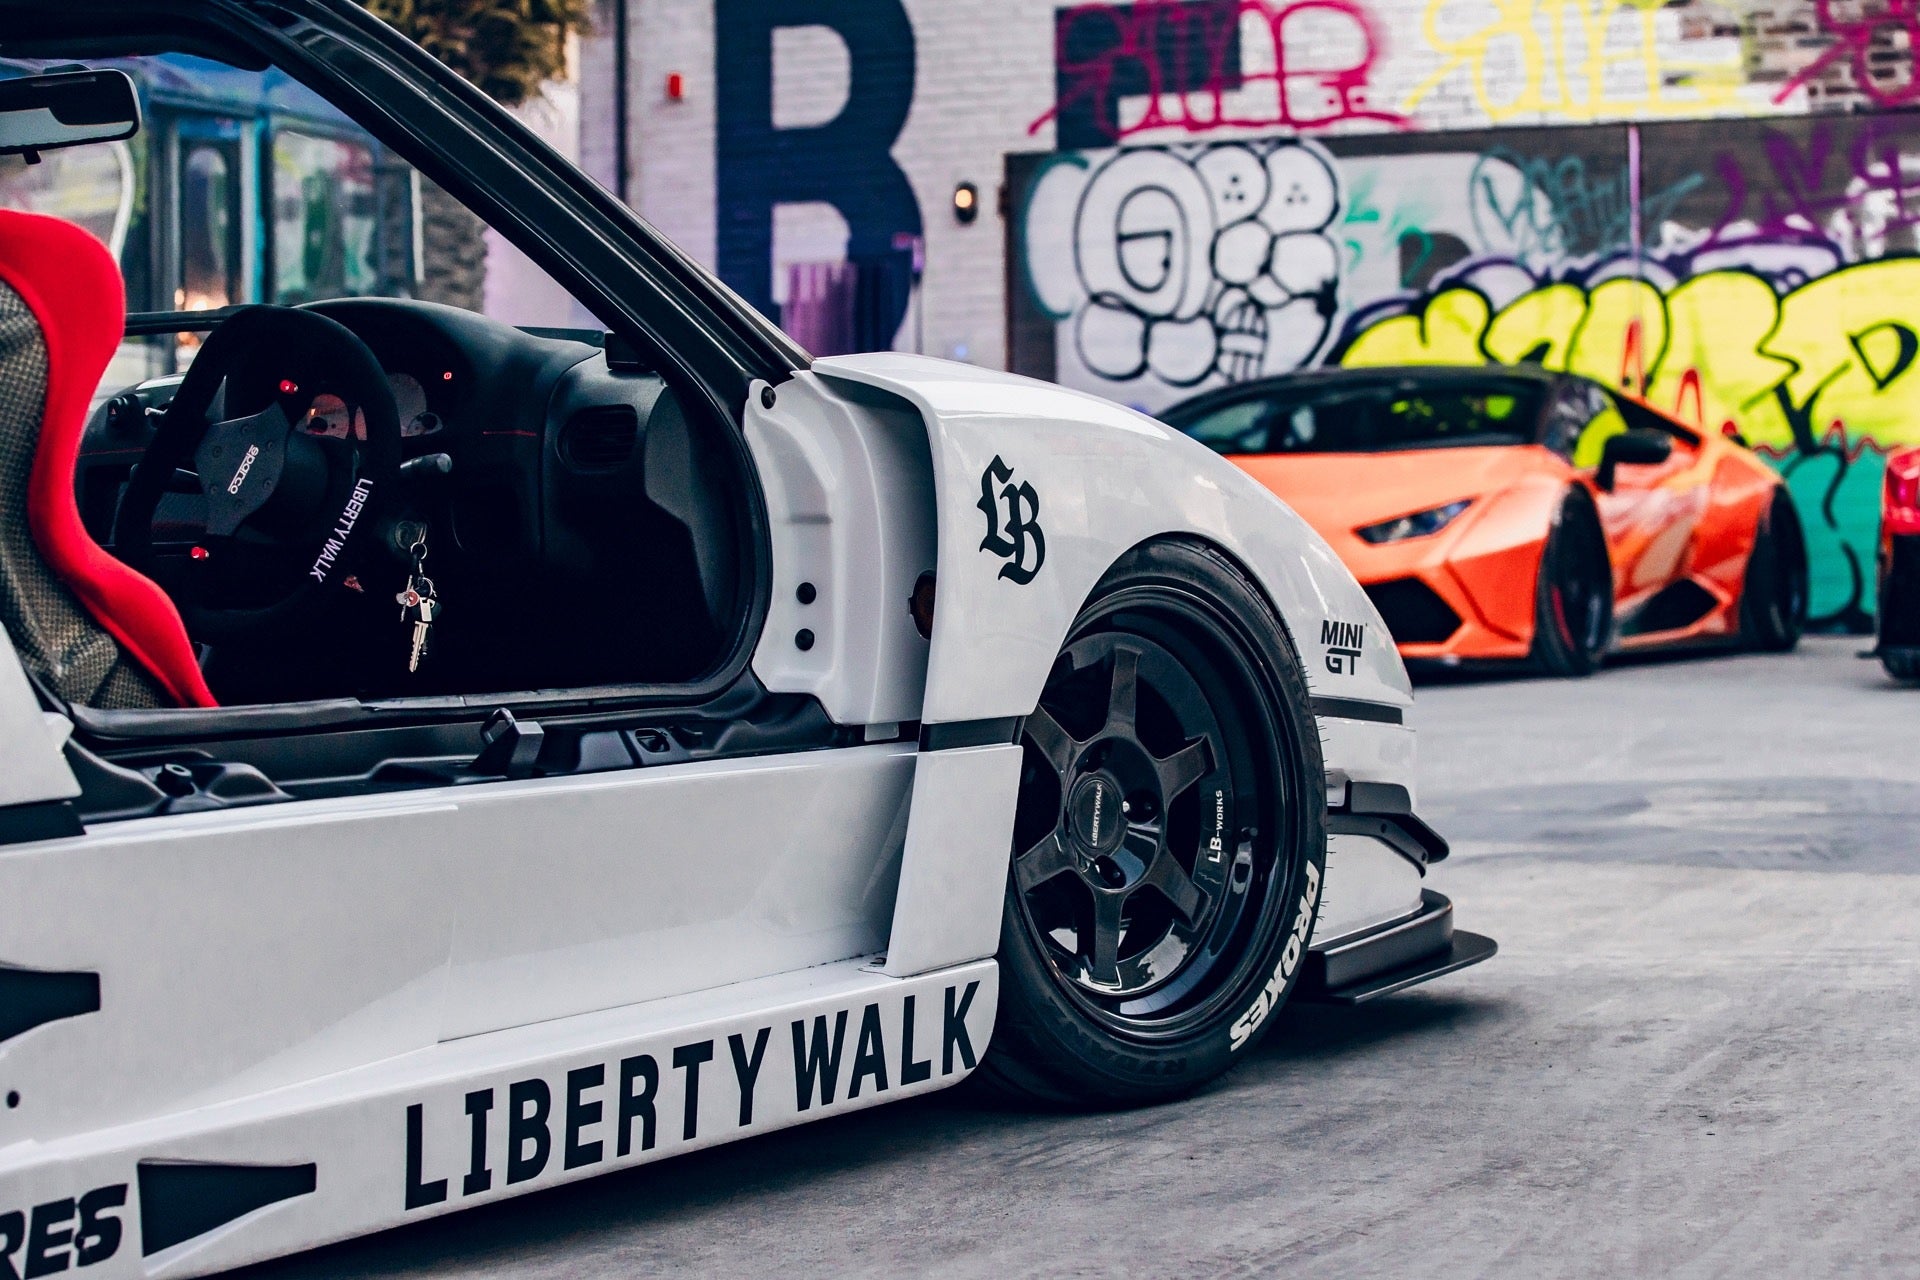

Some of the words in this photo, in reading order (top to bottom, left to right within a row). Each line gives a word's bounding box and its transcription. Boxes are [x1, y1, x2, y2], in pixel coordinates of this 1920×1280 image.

[334, 478, 374, 541] LIBERTY
[309, 537, 345, 583] WALK
[1320, 619, 1364, 649] MINI
[1325, 647, 1362, 676] GT
[1229, 860, 1321, 1052] PROXES
[404, 1026, 772, 1212] LIBERTY
[791, 980, 981, 1112] WALK
